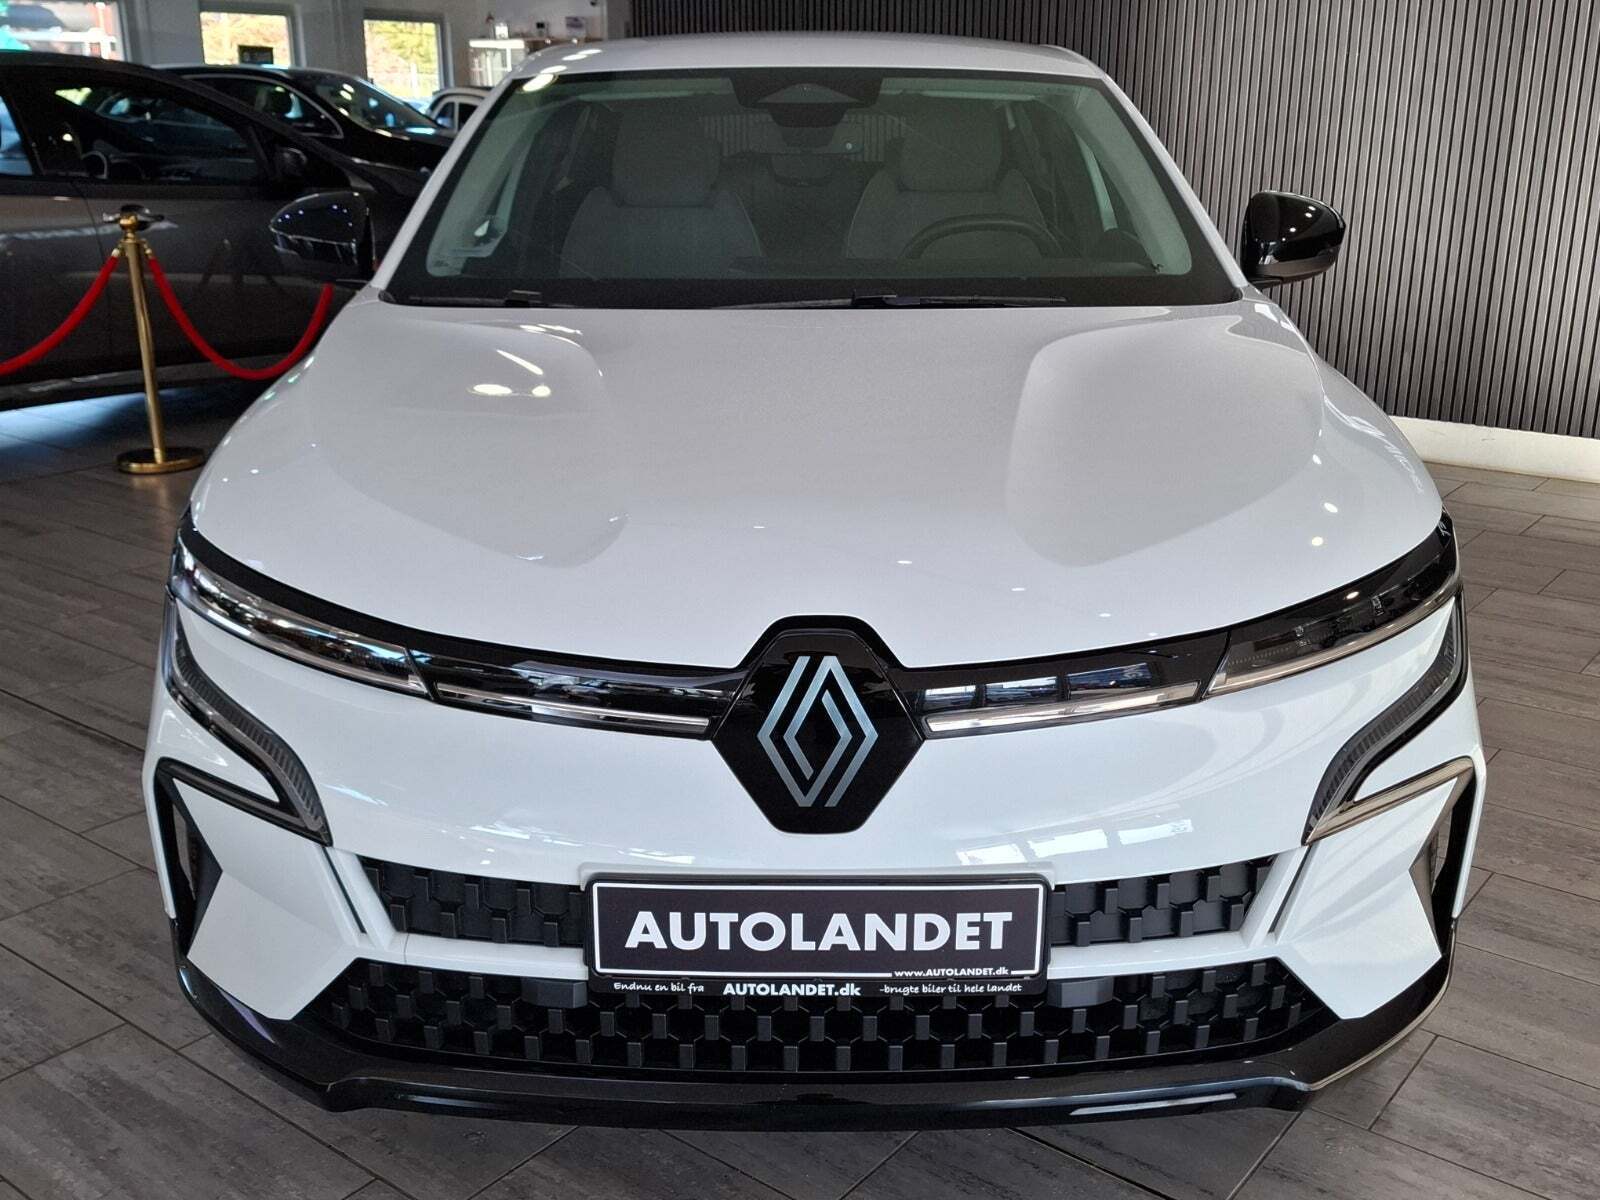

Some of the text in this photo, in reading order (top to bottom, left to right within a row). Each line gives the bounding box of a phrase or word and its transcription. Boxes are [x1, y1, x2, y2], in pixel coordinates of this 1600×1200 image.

[624, 911, 1013, 952] AUTOLANDET
[894, 966, 1009, 977] www.AUTOLANDET.dk
[613, 982, 705, 995] Endnu en bil fra
[722, 983, 861, 996] AUTOLANDET.dk
[879, 982, 1022, 996] -brugte biler til hele landet
